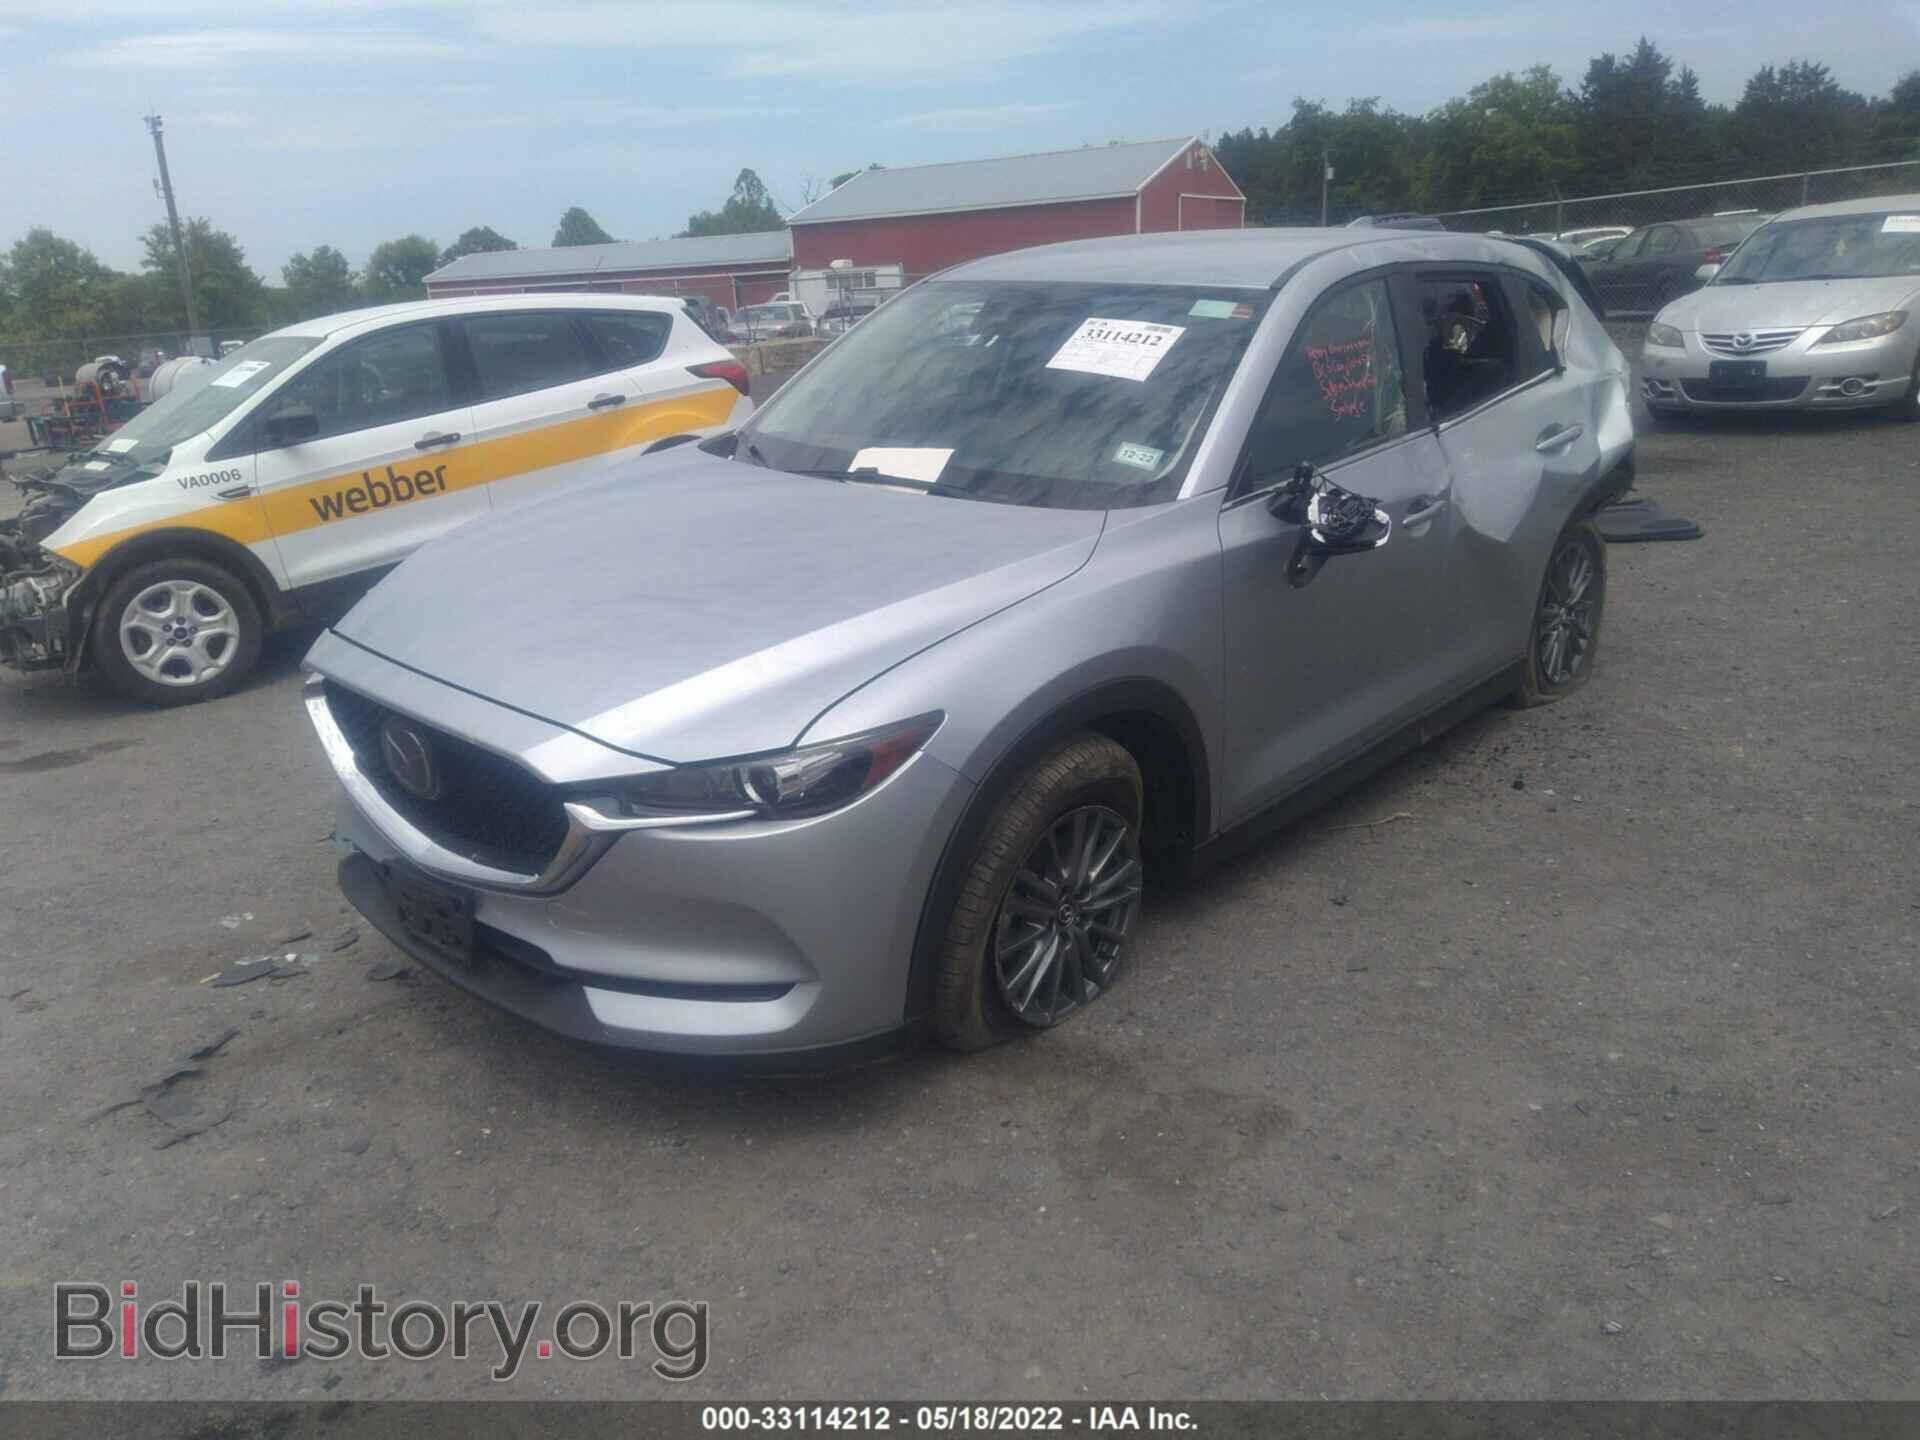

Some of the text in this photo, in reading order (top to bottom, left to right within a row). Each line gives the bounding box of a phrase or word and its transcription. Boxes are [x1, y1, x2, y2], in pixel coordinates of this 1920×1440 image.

[1081, 328, 1163, 346] 33114212
[177, 468, 242, 490] VA0006
[309, 464, 448, 521] webber
